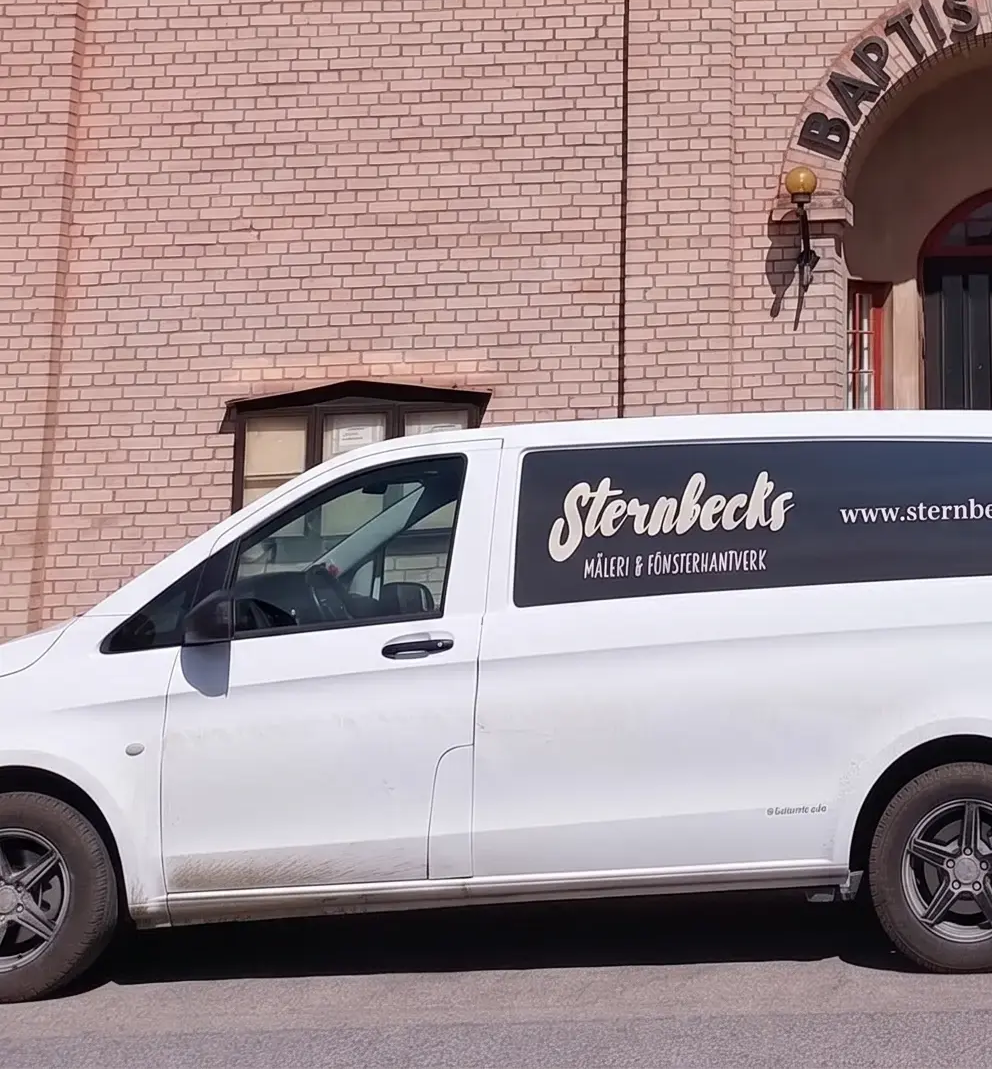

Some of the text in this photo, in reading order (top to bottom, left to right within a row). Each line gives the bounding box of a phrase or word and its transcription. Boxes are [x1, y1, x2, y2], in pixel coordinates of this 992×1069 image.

[548, 471, 795, 562] Sternbecks
[635, 555, 644, 577] &
[648, 549, 767, 576] FÖNSTERHANTVERK
